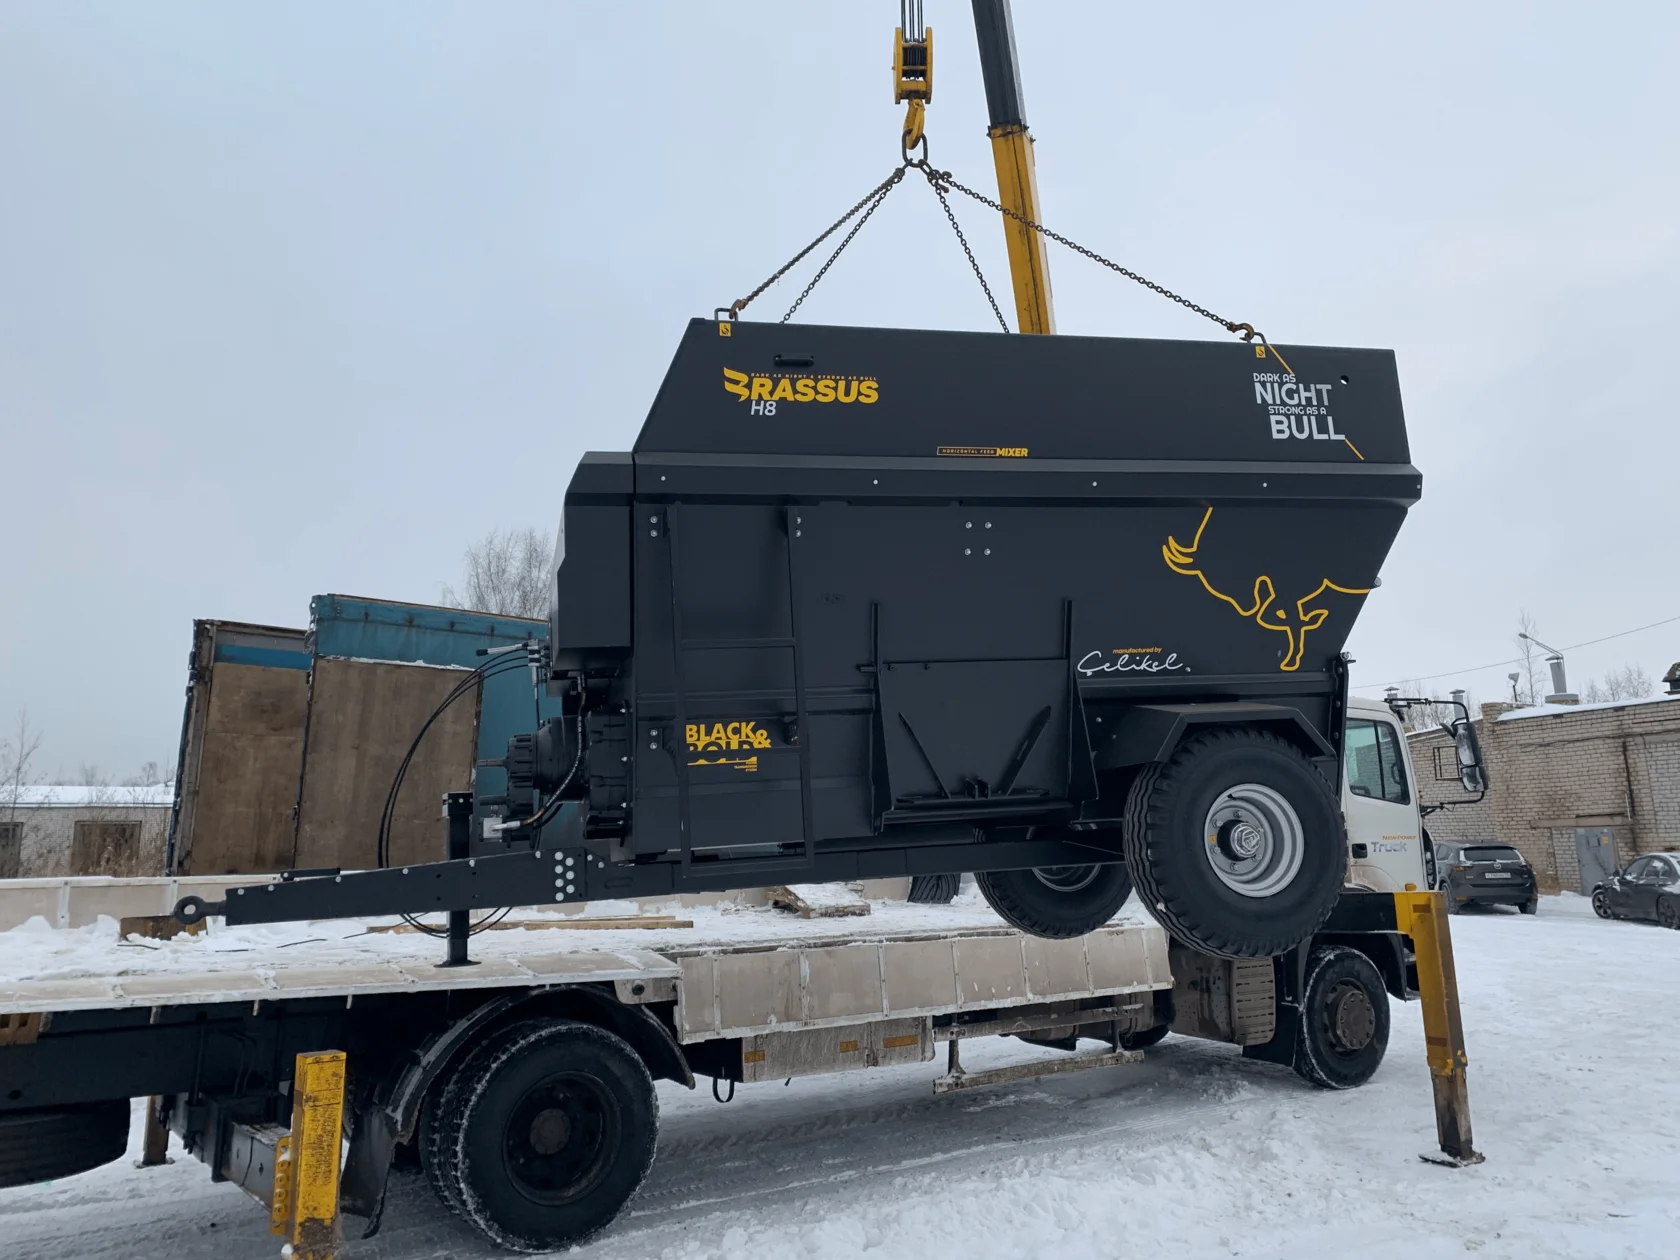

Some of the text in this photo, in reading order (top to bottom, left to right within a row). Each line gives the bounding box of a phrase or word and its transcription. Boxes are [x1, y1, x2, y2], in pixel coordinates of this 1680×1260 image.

[1253, 373, 1297, 383] DARK AS
[1254, 382, 1332, 406] NIGHT
[751, 401, 777, 416] H8
[1268, 406, 1327, 415] STRONG AS A
[1269, 414, 1346, 440] BULL
[996, 447, 1029, 457] MIXER
[1371, 841, 1408, 853] Truck
